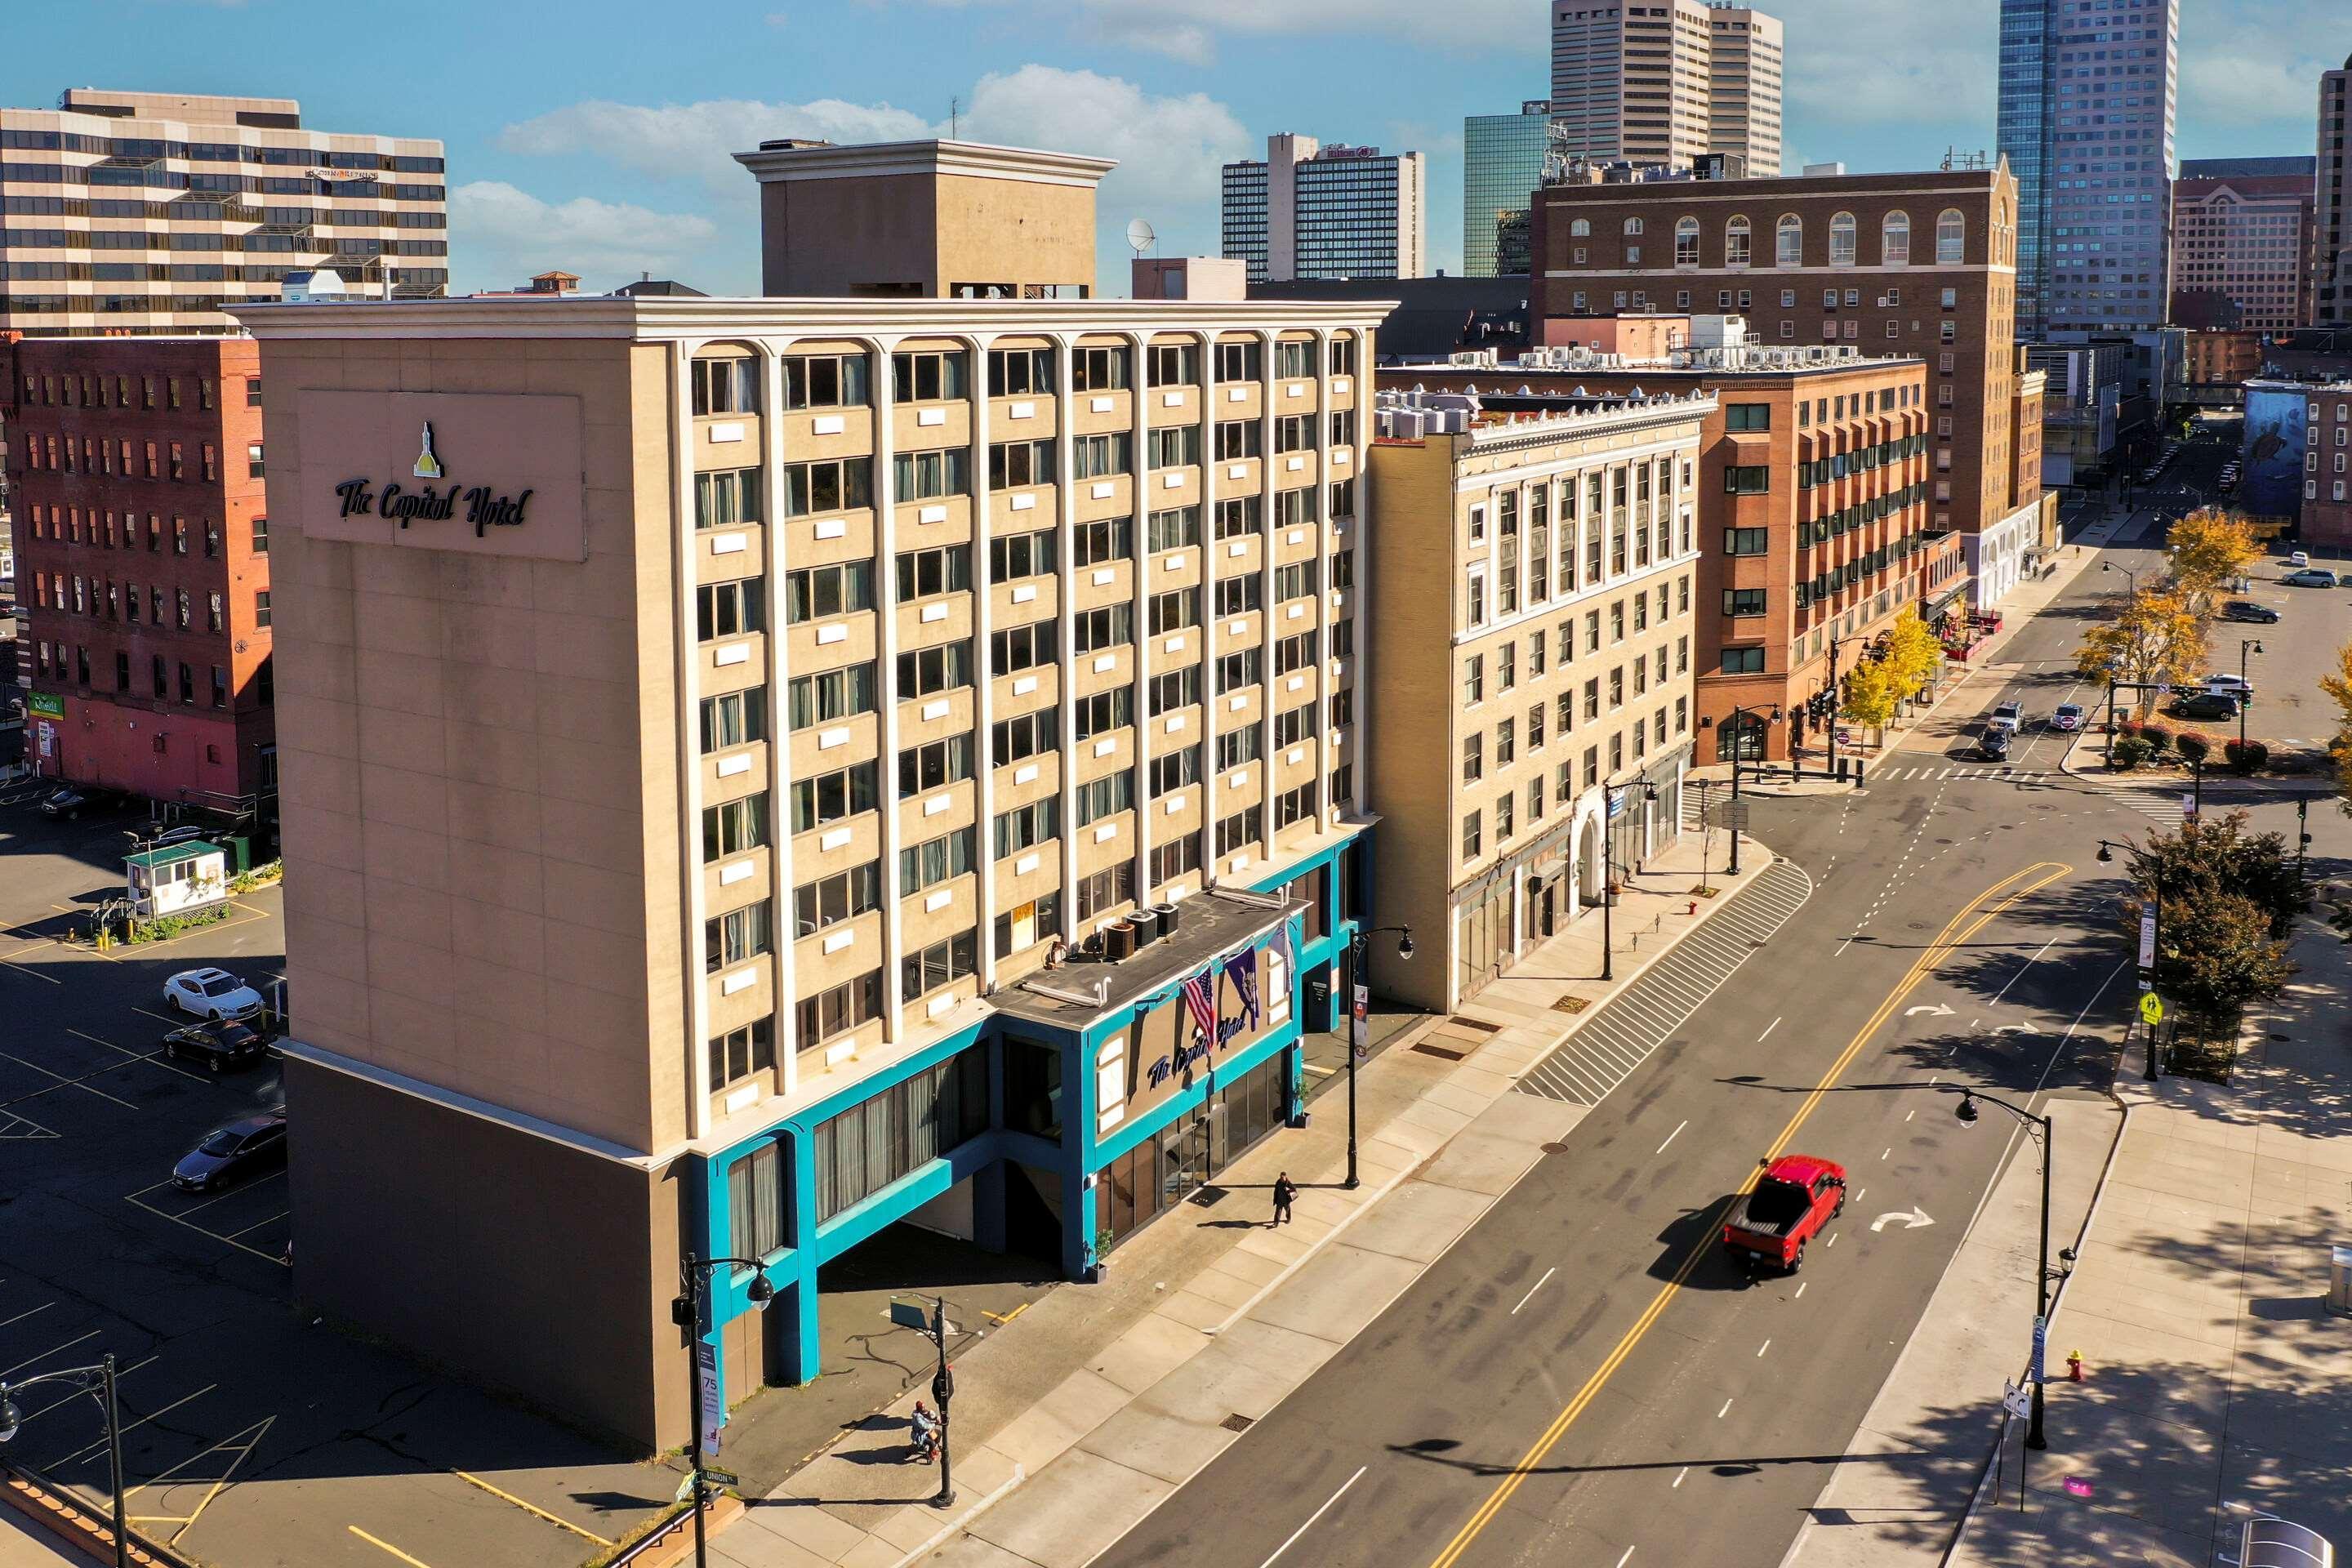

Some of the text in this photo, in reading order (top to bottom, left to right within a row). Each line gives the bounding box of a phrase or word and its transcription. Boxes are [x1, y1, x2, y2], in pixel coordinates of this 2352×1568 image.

[1327, 149, 1354, 158] Hilton
[335, 479, 373, 518] The
[462, 487, 533, 537] Hotel
[2143, 923, 2154, 931] 75
[1147, 1055, 1171, 1091] The
[1216, 1005, 1246, 1052] Hotel
[703, 1376, 718, 1390] 75
[706, 1471, 728, 1483] UNION
